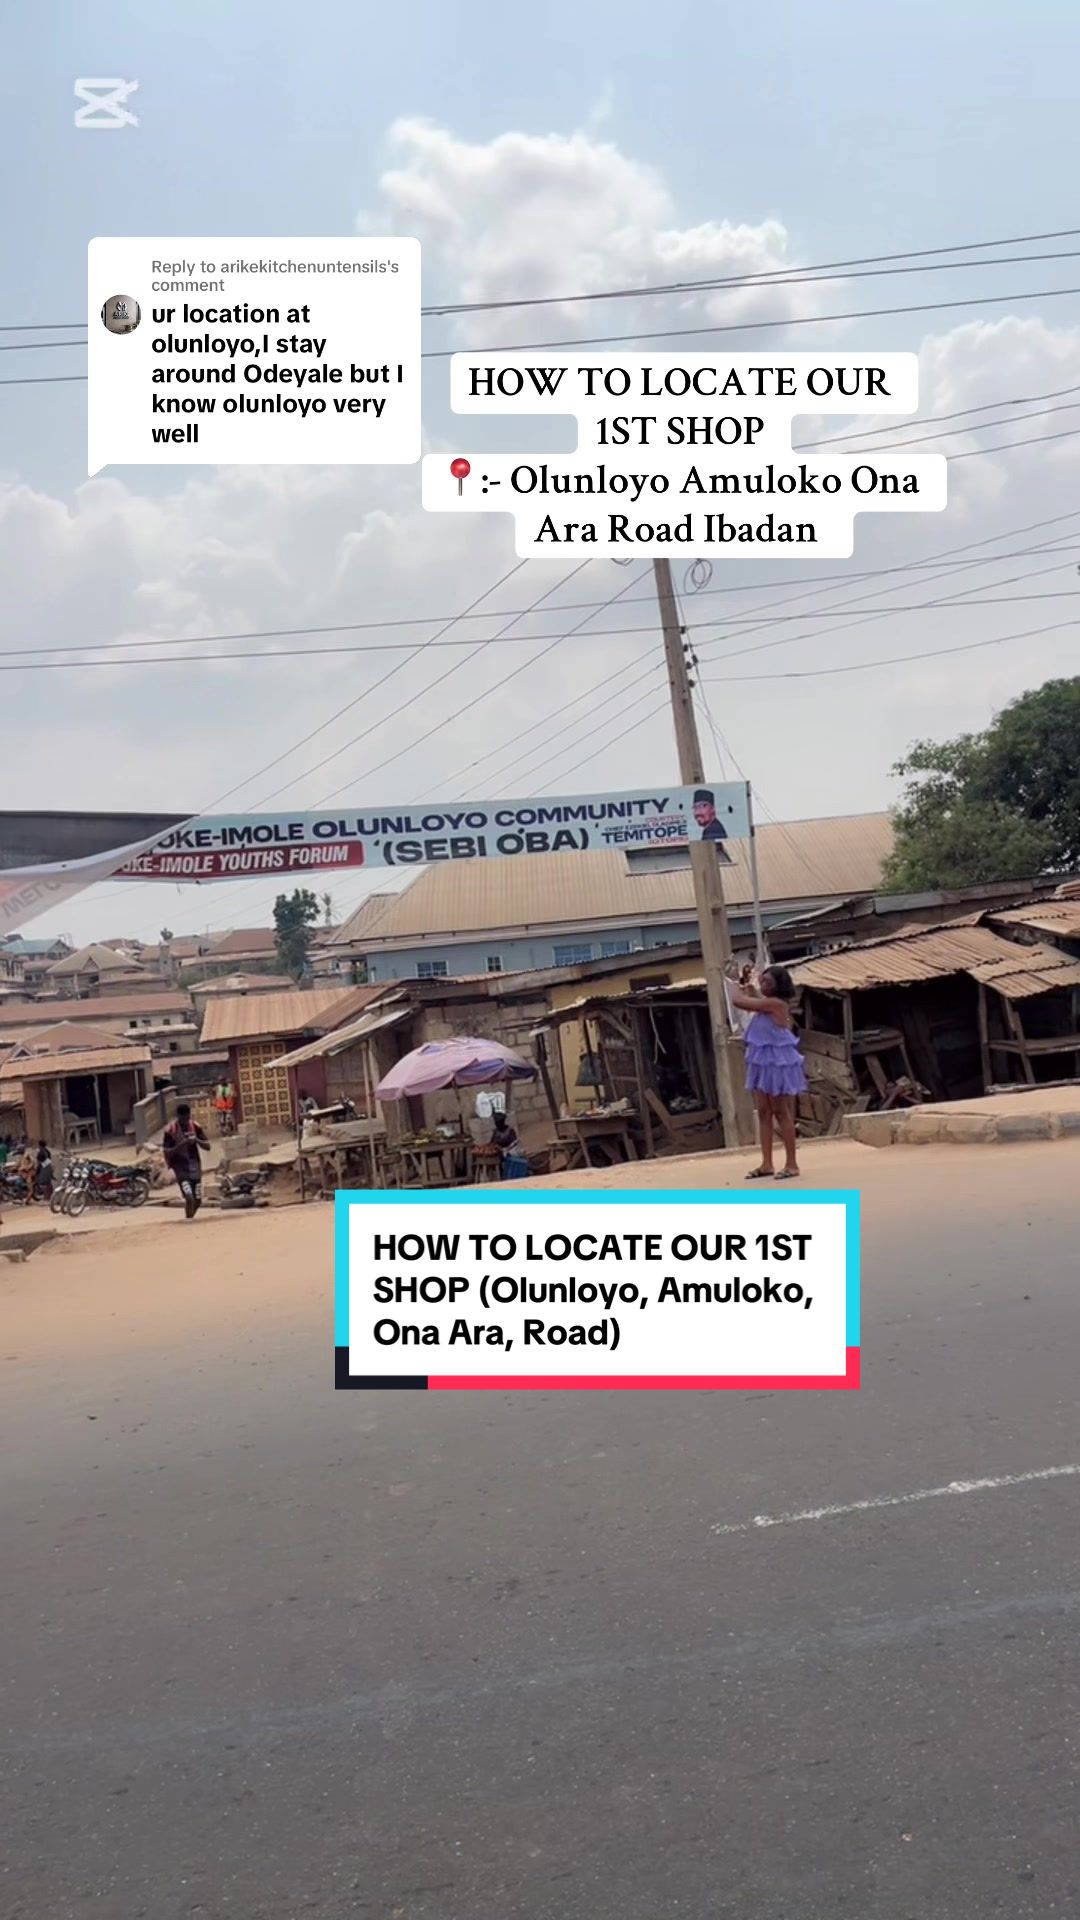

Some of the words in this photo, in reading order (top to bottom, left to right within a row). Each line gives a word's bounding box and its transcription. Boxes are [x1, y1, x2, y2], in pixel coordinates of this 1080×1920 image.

[312, 812, 488, 838] OLUNLOYO
[495, 798, 670, 826] COMMUNITY
[602, 825, 688, 843] TEMITOPE
[219, 848, 284, 871] YOUTHS
[289, 846, 349, 866] FORUM
[382, 835, 487, 865] (SEBI
